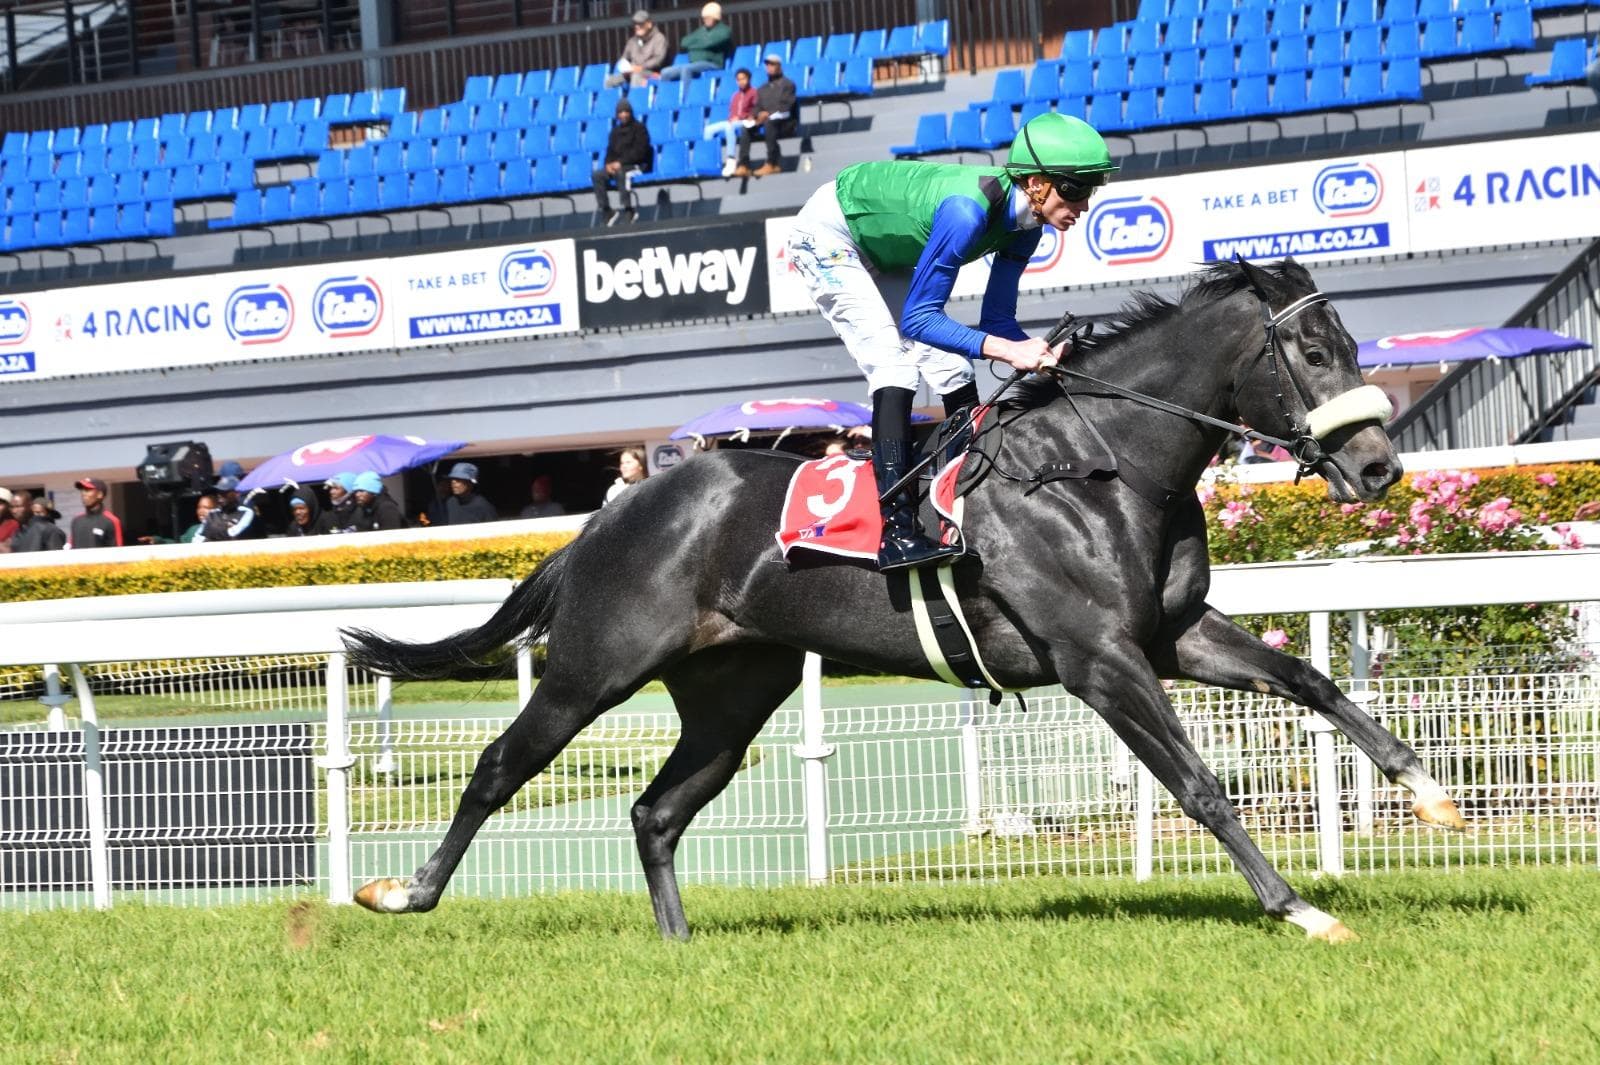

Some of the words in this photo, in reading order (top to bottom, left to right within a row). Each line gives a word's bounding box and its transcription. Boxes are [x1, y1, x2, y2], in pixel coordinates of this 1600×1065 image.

[1202, 194, 1244, 211] TAKE
[1251, 193, 1261, 206] A
[1268, 188, 1299, 204] BET
[1323, 177, 1377, 206] tab
[1454, 174, 1475, 206] 4
[1099, 214, 1166, 251] tab
[1213, 227, 1378, 260] WWW.TAB.CO.ZA
[408, 277, 442, 290] TAKE
[448, 275, 457, 286] A
[462, 271, 487, 286] BET
[507, 260, 552, 288] tab
[583, 246, 757, 305] betway
[82, 311, 97, 338] 4
[106, 301, 211, 337] RACING
[234, 299, 288, 332] tab
[322, 291, 377, 325] tab
[416, 307, 554, 336] WWW.TAB.CO.ZA
[807, 456, 861, 522] 3
